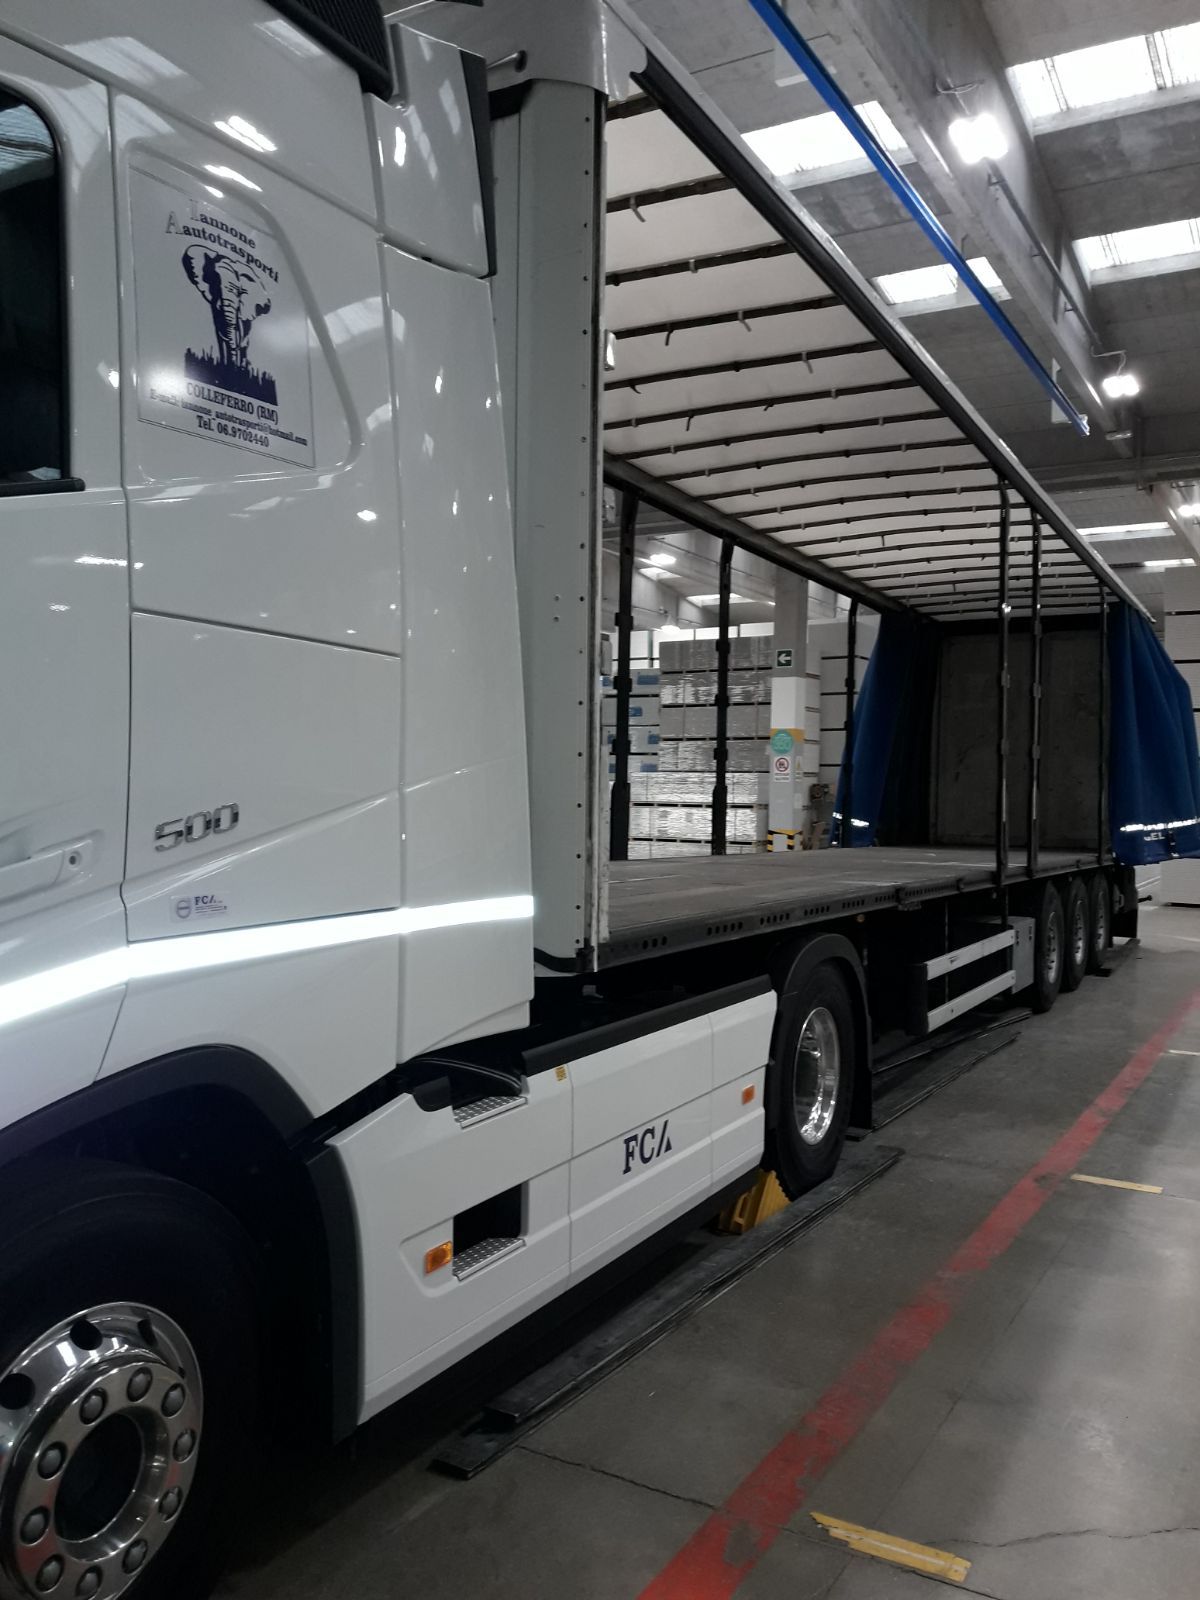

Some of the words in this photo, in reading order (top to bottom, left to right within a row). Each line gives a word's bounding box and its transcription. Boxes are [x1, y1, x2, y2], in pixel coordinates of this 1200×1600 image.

[189, 199, 256, 249] Iannone
[187, 382, 253, 414] COLLEFERRO
[257, 405, 279, 425] (RM)
[217, 422, 269, 448] 06.9702440
[154, 802, 239, 852] 500
[622, 1119, 673, 1175] FCA
